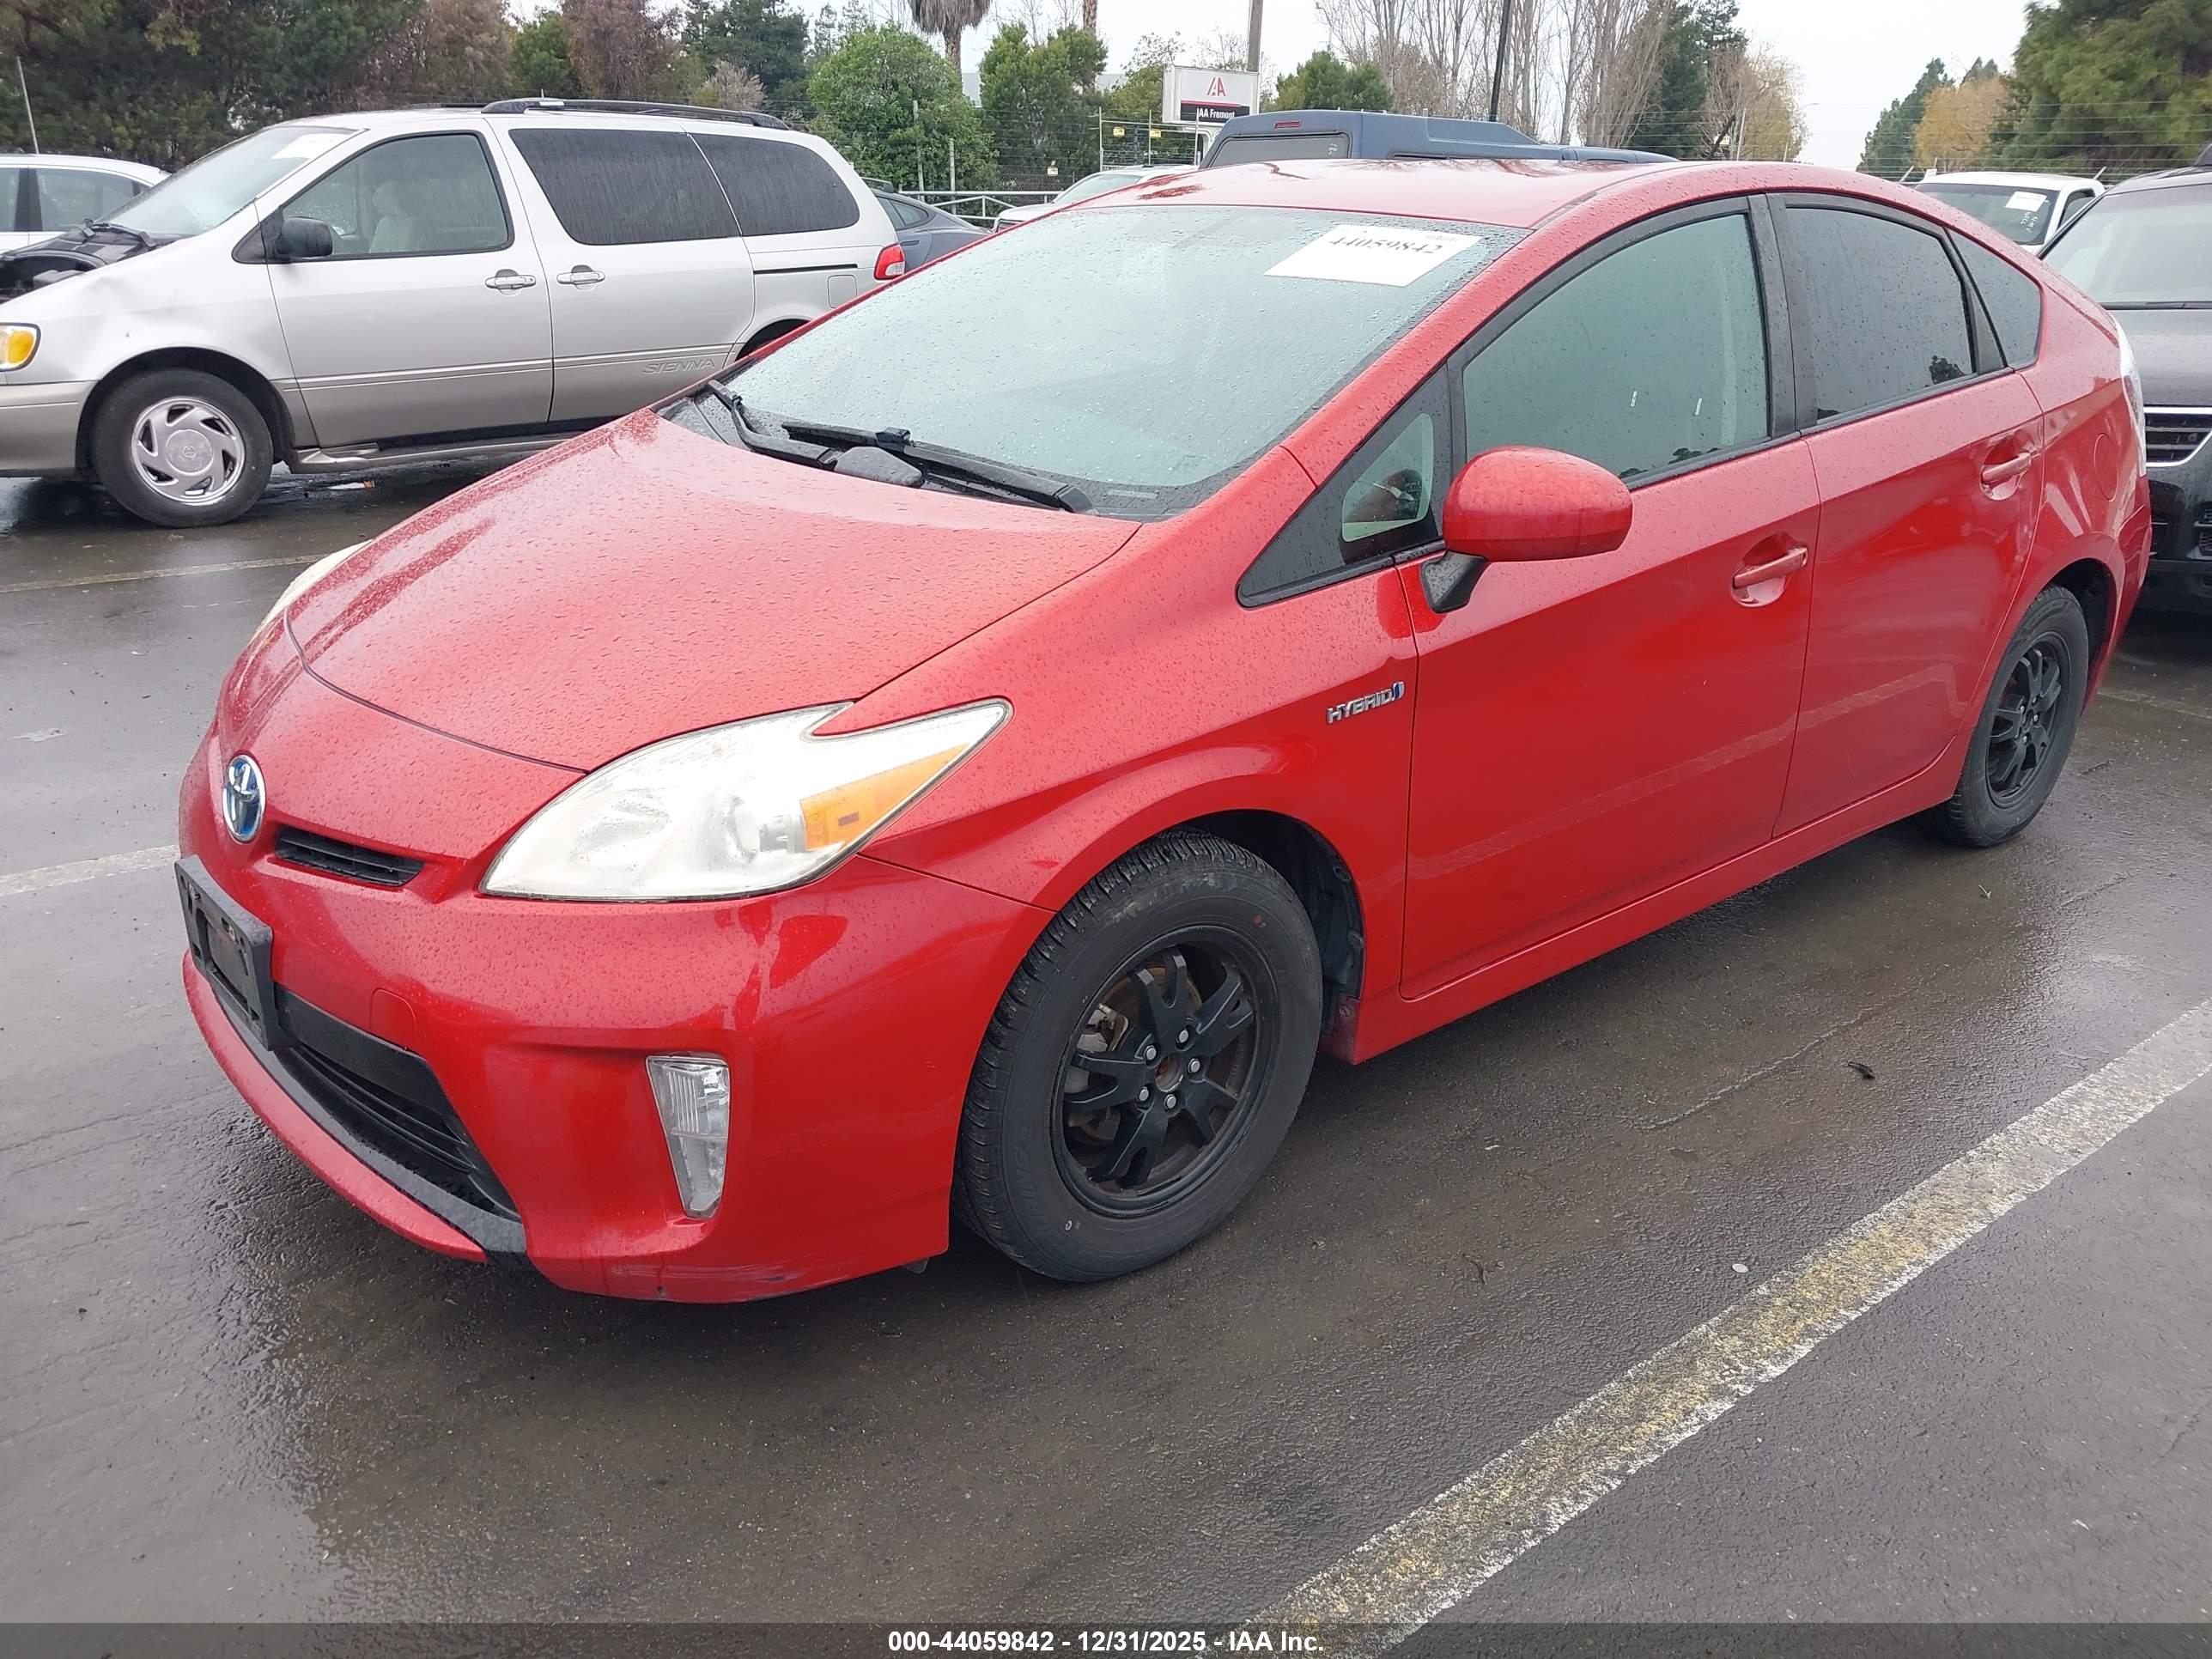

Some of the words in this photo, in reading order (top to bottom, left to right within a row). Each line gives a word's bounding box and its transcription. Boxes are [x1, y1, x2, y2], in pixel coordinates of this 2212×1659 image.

[1210, 108, 1236, 119] Fremont
[1328, 235, 1443, 254] 44059842
[642, 358, 715, 374] SIENNA
[1326, 688, 1394, 724] HYBRID
